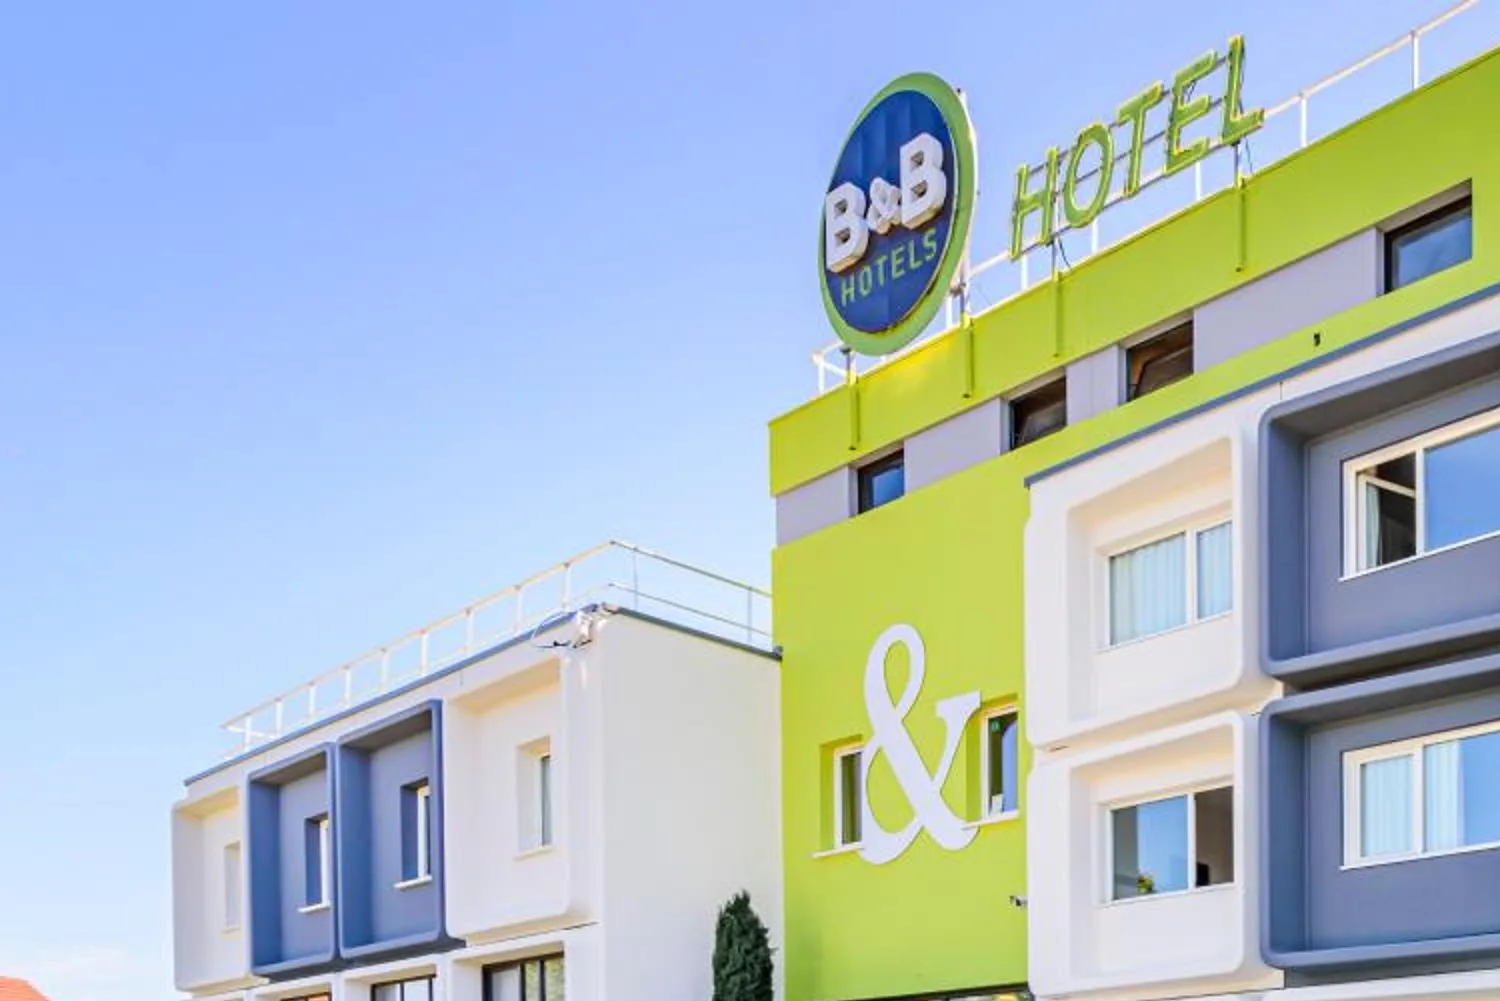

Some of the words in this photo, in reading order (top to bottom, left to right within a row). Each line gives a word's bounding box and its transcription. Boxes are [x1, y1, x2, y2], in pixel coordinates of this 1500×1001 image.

[826, 132, 947, 273] B&B
[1009, 34, 1264, 262] HOTEL
[841, 228, 937, 306] HOTELS
[857, 623, 981, 864] &
